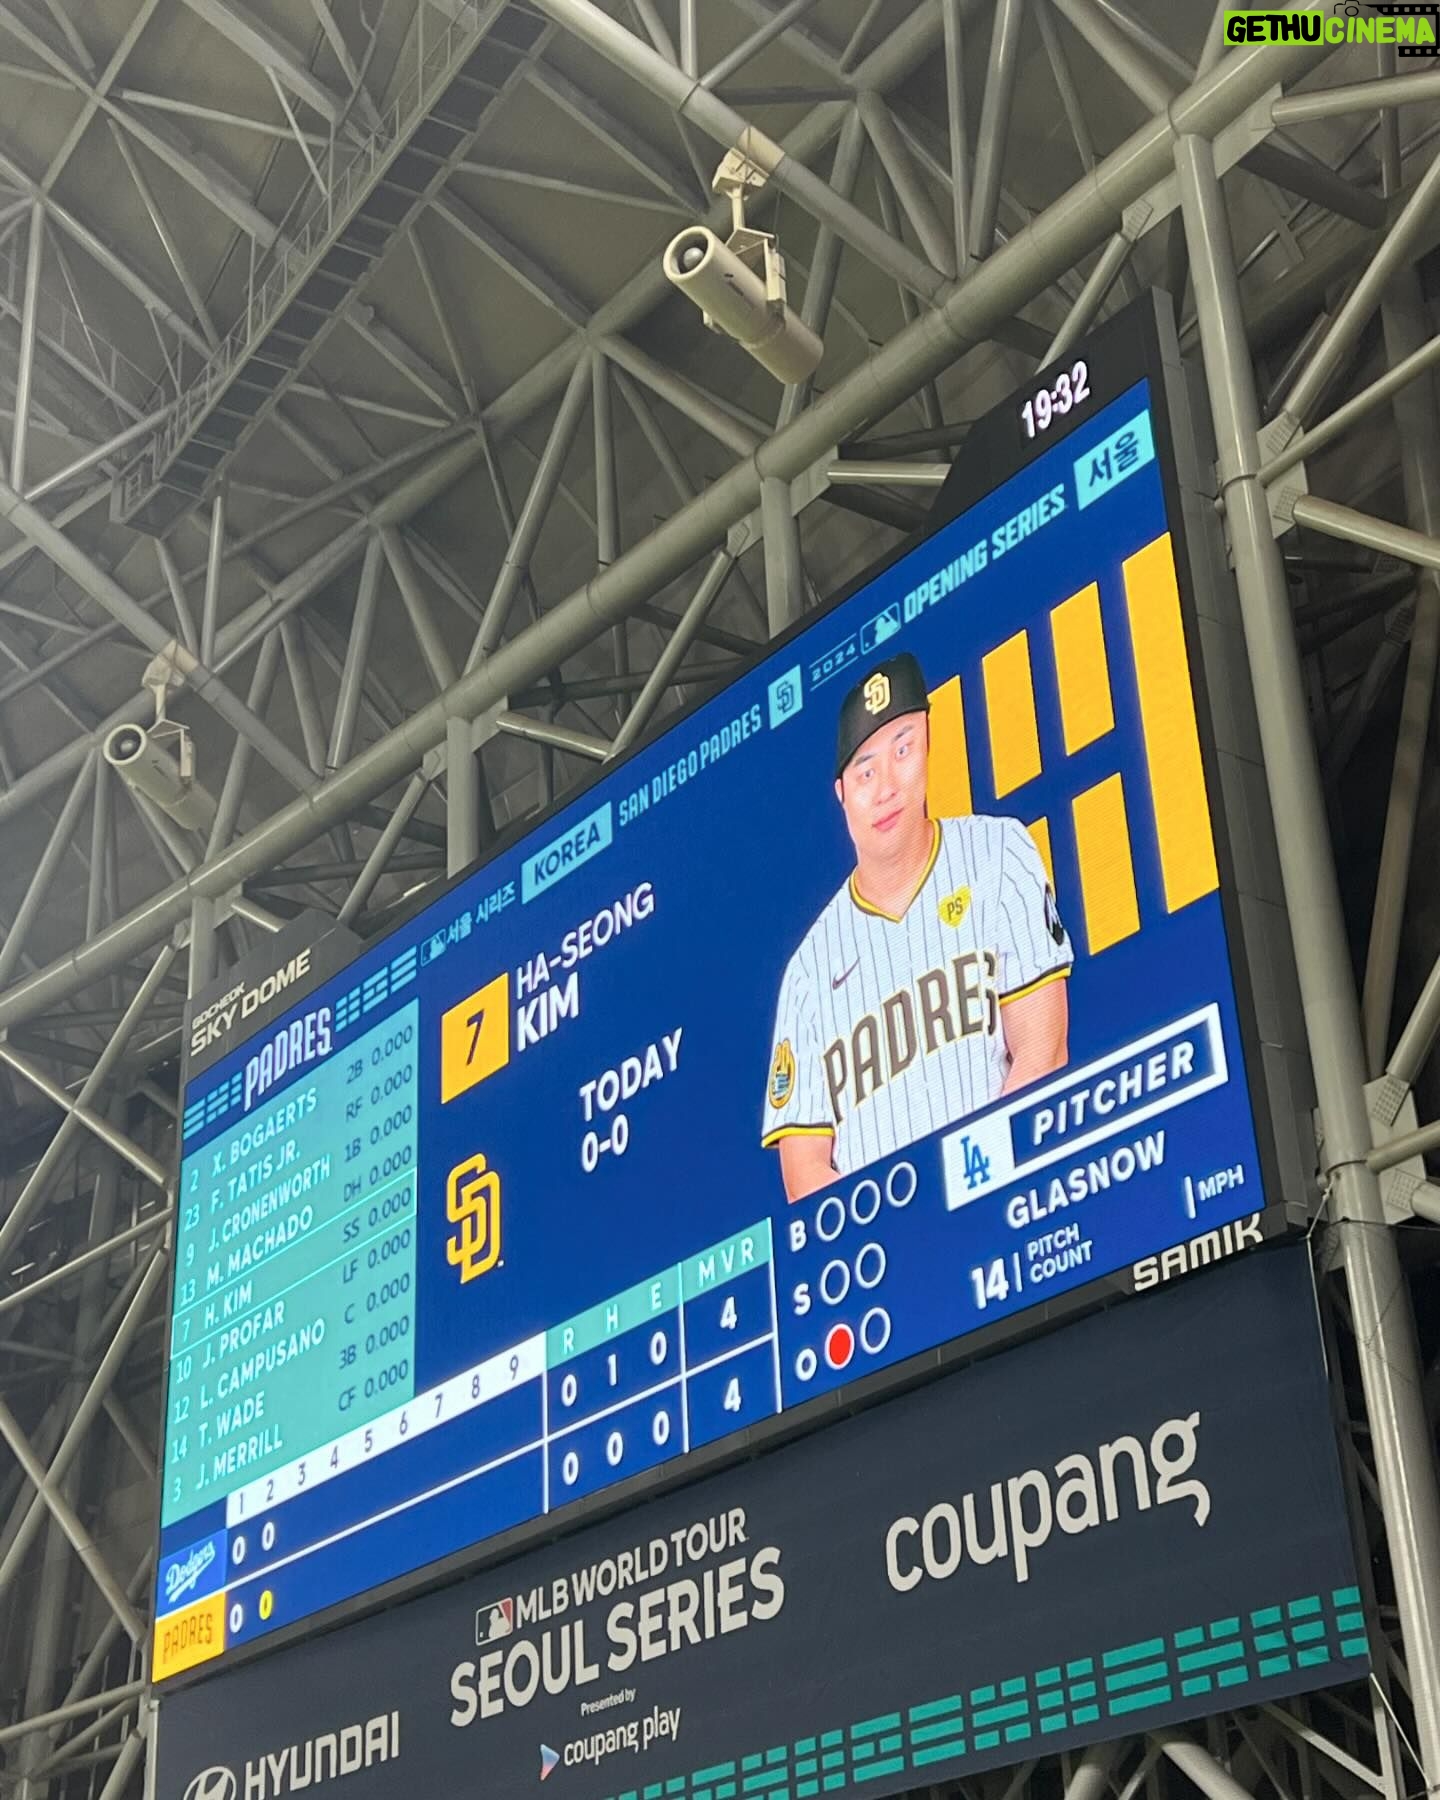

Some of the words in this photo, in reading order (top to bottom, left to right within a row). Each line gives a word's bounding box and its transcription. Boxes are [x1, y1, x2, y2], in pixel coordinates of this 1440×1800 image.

[1021, 360, 1090, 439] 19:32
[1089, 431, 1140, 488] 서울
[904, 539, 988, 623] OPENING
[992, 483, 1066, 559] SERIES
[811, 644, 856, 682] 2024
[618, 784, 650, 827] SAN
[652, 750, 698, 806] DIEGO
[700, 704, 762, 770] PADRES
[534, 822, 600, 886] KOREA
[446, 913, 472, 944] 서울
[476, 881, 516, 926] 시리즈
[516, 882, 655, 1000] HA-SEONG
[946, 896, 964, 921] PS
[190, 1003, 238, 1057] SKY
[241, 948, 312, 1019] DOME
[465, 1009, 485, 1066] 7
[516, 972, 580, 1053] KIM
[190, 1169, 199, 1192] 2
[211, 1152, 226, 1177] X.
[230, 1087, 317, 1165] BOGAERTS
[346, 1059, 363, 1084] 2B
[371, 1025, 413, 1066] 0.000
[244, 1007, 333, 1112] PADRES
[579, 1027, 683, 1122] TODAY
[1032, 1040, 1196, 1146] PITCHER
[184, 1203, 200, 1232] 23
[211, 1189, 224, 1214] F.
[228, 1154, 273, 1200] TATIS
[276, 1139, 301, 1170] JR.
[346, 1098, 363, 1123] RF
[370, 1064, 413, 1105] 0.000
[186, 1243, 195, 1267] 9
[208, 1229, 219, 1253] J.
[222, 1154, 331, 1243] CRONENWORTH
[344, 1137, 361, 1162] 1B
[369, 1104, 412, 1146] 0.000
[581, 1114, 629, 1173] 0-0
[960, 1134, 991, 1190] LA
[1005, 1130, 1167, 1229] GLASNOW
[1199, 1164, 1245, 1202] MPH
[180, 1278, 196, 1308] 13
[206, 1265, 225, 1291] M.
[227, 1205, 313, 1274] MACHADO
[343, 1175, 362, 1202] DH
[369, 1145, 412, 1186] 0.000
[182, 1318, 190, 1342] 7
[204, 1301, 220, 1329] H.
[223, 1280, 253, 1316] KIM
[342, 1218, 360, 1244] SS
[368, 1187, 411, 1227] 0.000
[789, 1219, 807, 1252] B
[1026, 1223, 1080, 1262] PITCH
[1028, 1240, 1094, 1284] COUNT
[1133, 1213, 1264, 1292] SAMIK
[176, 1359, 192, 1385] 10
[202, 1343, 215, 1368] J.
[219, 1299, 285, 1359] PROFAR
[342, 1258, 359, 1284] LF
[367, 1228, 411, 1269] 0.000
[793, 1282, 812, 1315] S
[970, 1258, 1009, 1309] 14
[171, 1435, 188, 1464] 14
[199, 1422, 212, 1449] T.
[216, 1391, 265, 1440] WADE
[339, 1343, 357, 1370] 3B
[365, 1315, 410, 1355] 0.000
[174, 1395, 190, 1424] 12
[200, 1383, 214, 1410] L.
[217, 1317, 326, 1399] CAMPUSANO
[343, 1302, 355, 1325] C
[366, 1272, 411, 1313] 0.000
[239, 1491, 244, 1515] 1
[266, 1479, 274, 1502] 2
[298, 1462, 306, 1485] 3
[330, 1445, 339, 1468] 4
[364, 1428, 373, 1453] 5
[399, 1411, 408, 1435] 6
[434, 1393, 444, 1418] 7
[471, 1374, 480, 1399] 8
[509, 1354, 519, 1381] 9
[563, 1327, 575, 1355] R
[606, 1307, 619, 1333] H
[651, 1282, 662, 1310] E
[698, 1237, 755, 1287] MVR
[165, 1540, 216, 1604] Dodgers
[232, 1536, 246, 1565] 0
[262, 1522, 275, 1551] 0
[561, 1374, 577, 1407] 0
[607, 1353, 617, 1386] 1
[650, 1331, 667, 1366] 0
[720, 1296, 737, 1330] 4
[173, 1477, 182, 1502] 3
[196, 1463, 210, 1490] J.
[213, 1424, 284, 1482] MERRILL
[338, 1388, 356, 1412] CF
[364, 1359, 409, 1399] 0.000
[163, 1612, 213, 1665] PADRES
[229, 1603, 243, 1633] 0
[259, 1590, 273, 1620] 0
[562, 1451, 579, 1485] 0
[606, 1431, 624, 1466] 0
[653, 1410, 670, 1445] 0
[723, 1377, 742, 1412] 4
[885, 1411, 1211, 1592] coupang
[515, 1578, 570, 1629] MLB
[572, 1538, 669, 1606] WORLD
[671, 1507, 747, 1567] TOUR
[450, 1619, 600, 1728] SEOUL
[606, 1546, 785, 1672] SERIES
[564, 1721, 639, 1766] coupang
[643, 1705, 681, 1750] play
[580, 1691, 625, 1717] Presented
[624, 1688, 636, 1703] by
[245, 1710, 400, 1800] HYUNDAI
